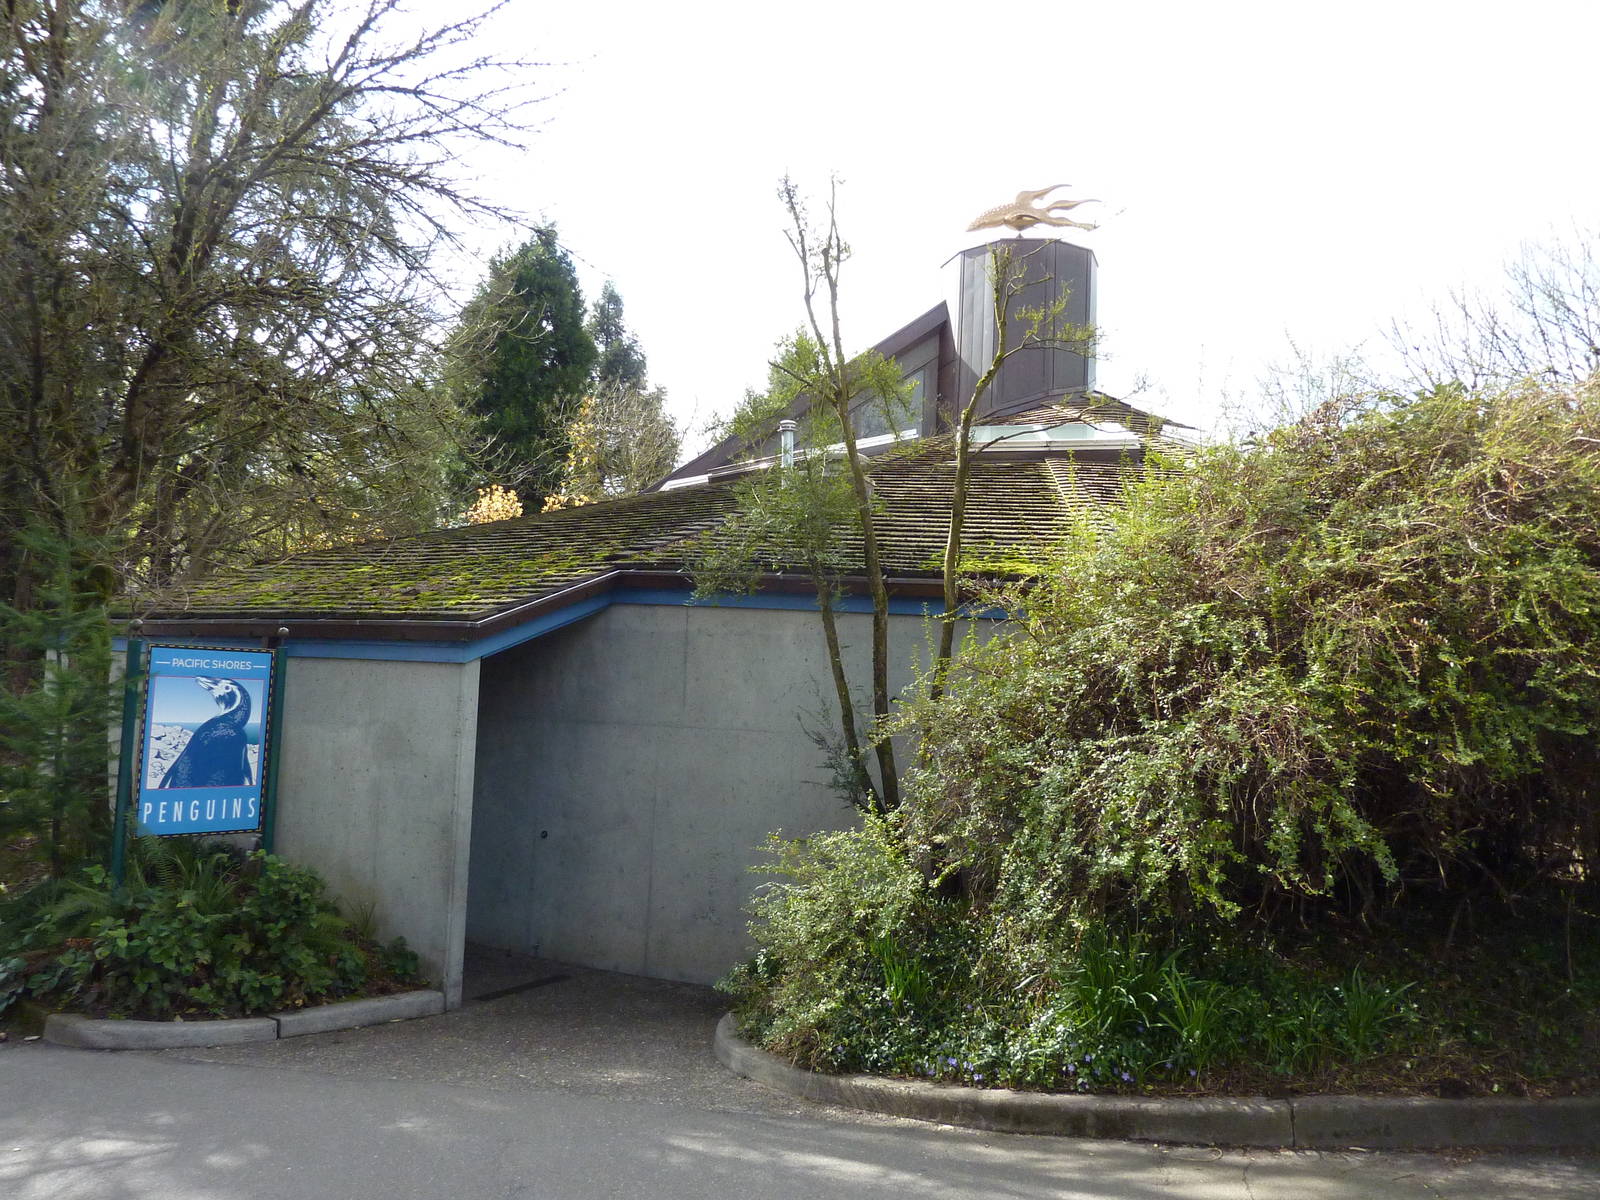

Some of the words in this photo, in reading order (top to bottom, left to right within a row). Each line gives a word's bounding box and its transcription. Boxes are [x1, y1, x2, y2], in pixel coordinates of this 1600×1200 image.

[172, 657, 210, 669] PACIFIC
[211, 659, 252, 670] SHORES
[143, 797, 255, 824] PENGUINS
